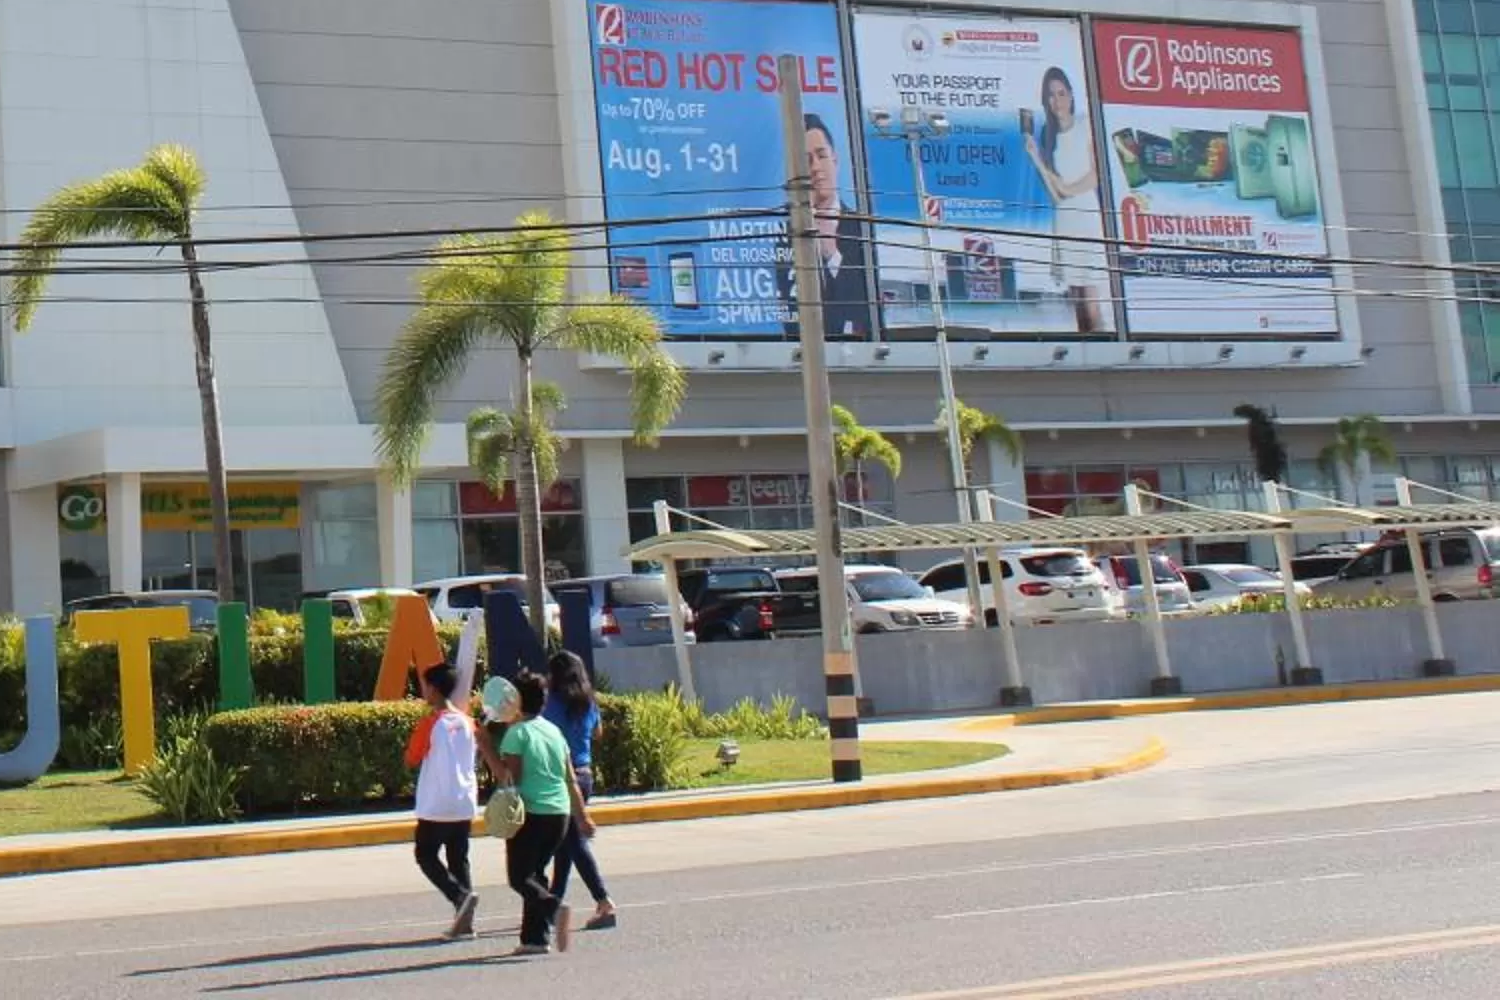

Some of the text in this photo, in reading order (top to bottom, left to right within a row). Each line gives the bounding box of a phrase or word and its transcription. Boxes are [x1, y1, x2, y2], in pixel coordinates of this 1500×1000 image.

[1167, 39, 1273, 67] Robinsons
[598, 48, 838, 93] RED HOT SLE
[892, 73, 1002, 90] YOUR PASSPORT
[1172, 66, 1282, 95] Appliances
[630, 97, 675, 121] 70%
[677, 103, 707, 118] OFF
[899, 91, 999, 108] TO THE FUTURE
[608, 140, 738, 179] Aug. 1-31
[957, 144, 1006, 165] OPEN
[707, 220, 789, 243] MARTIN
[1150, 213, 1253, 237] INSTALLMENT
[711, 246, 794, 262] DEL ROSARI
[716, 266, 781, 298] AUG.
